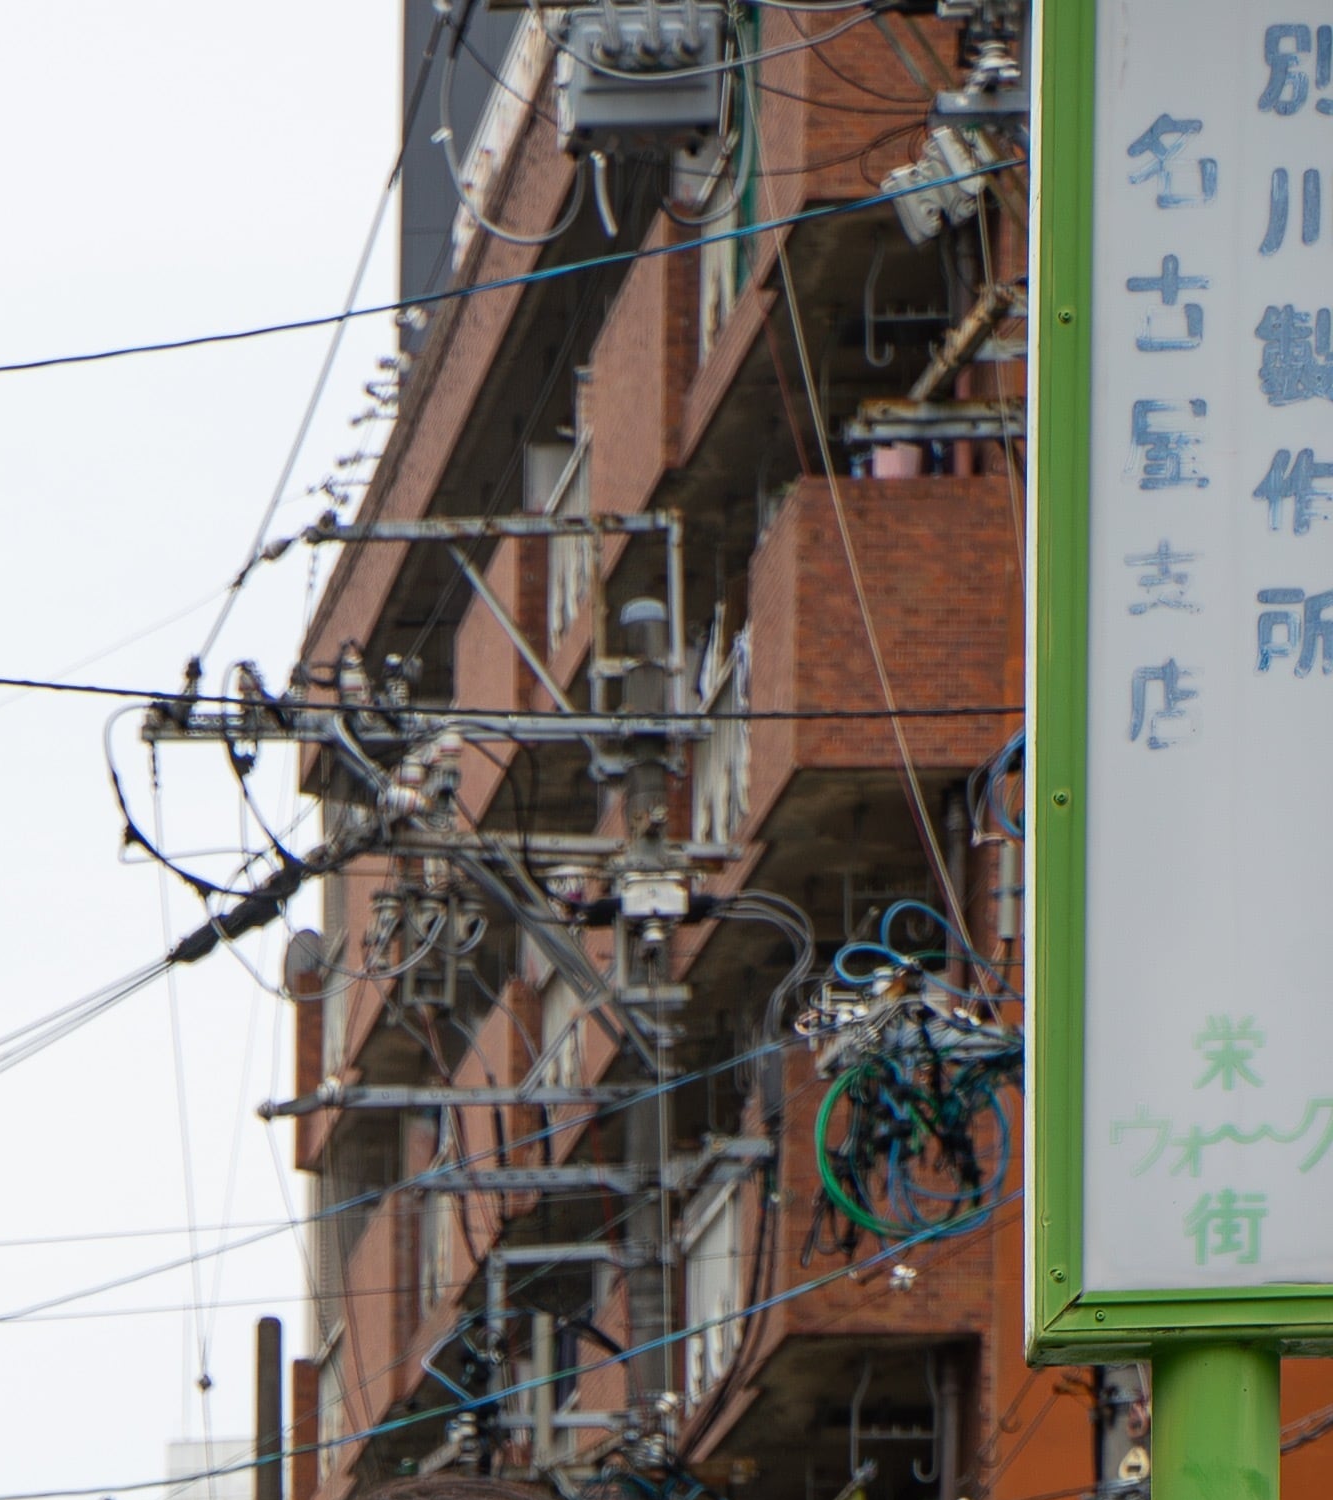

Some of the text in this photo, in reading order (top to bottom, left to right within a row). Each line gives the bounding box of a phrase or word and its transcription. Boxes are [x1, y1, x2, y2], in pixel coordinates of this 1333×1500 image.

[1121, 112, 1220, 750] 名古屋支店
[1192, 1013, 1268, 1091] 栄
[1183, 1187, 1269, 1266] 街
